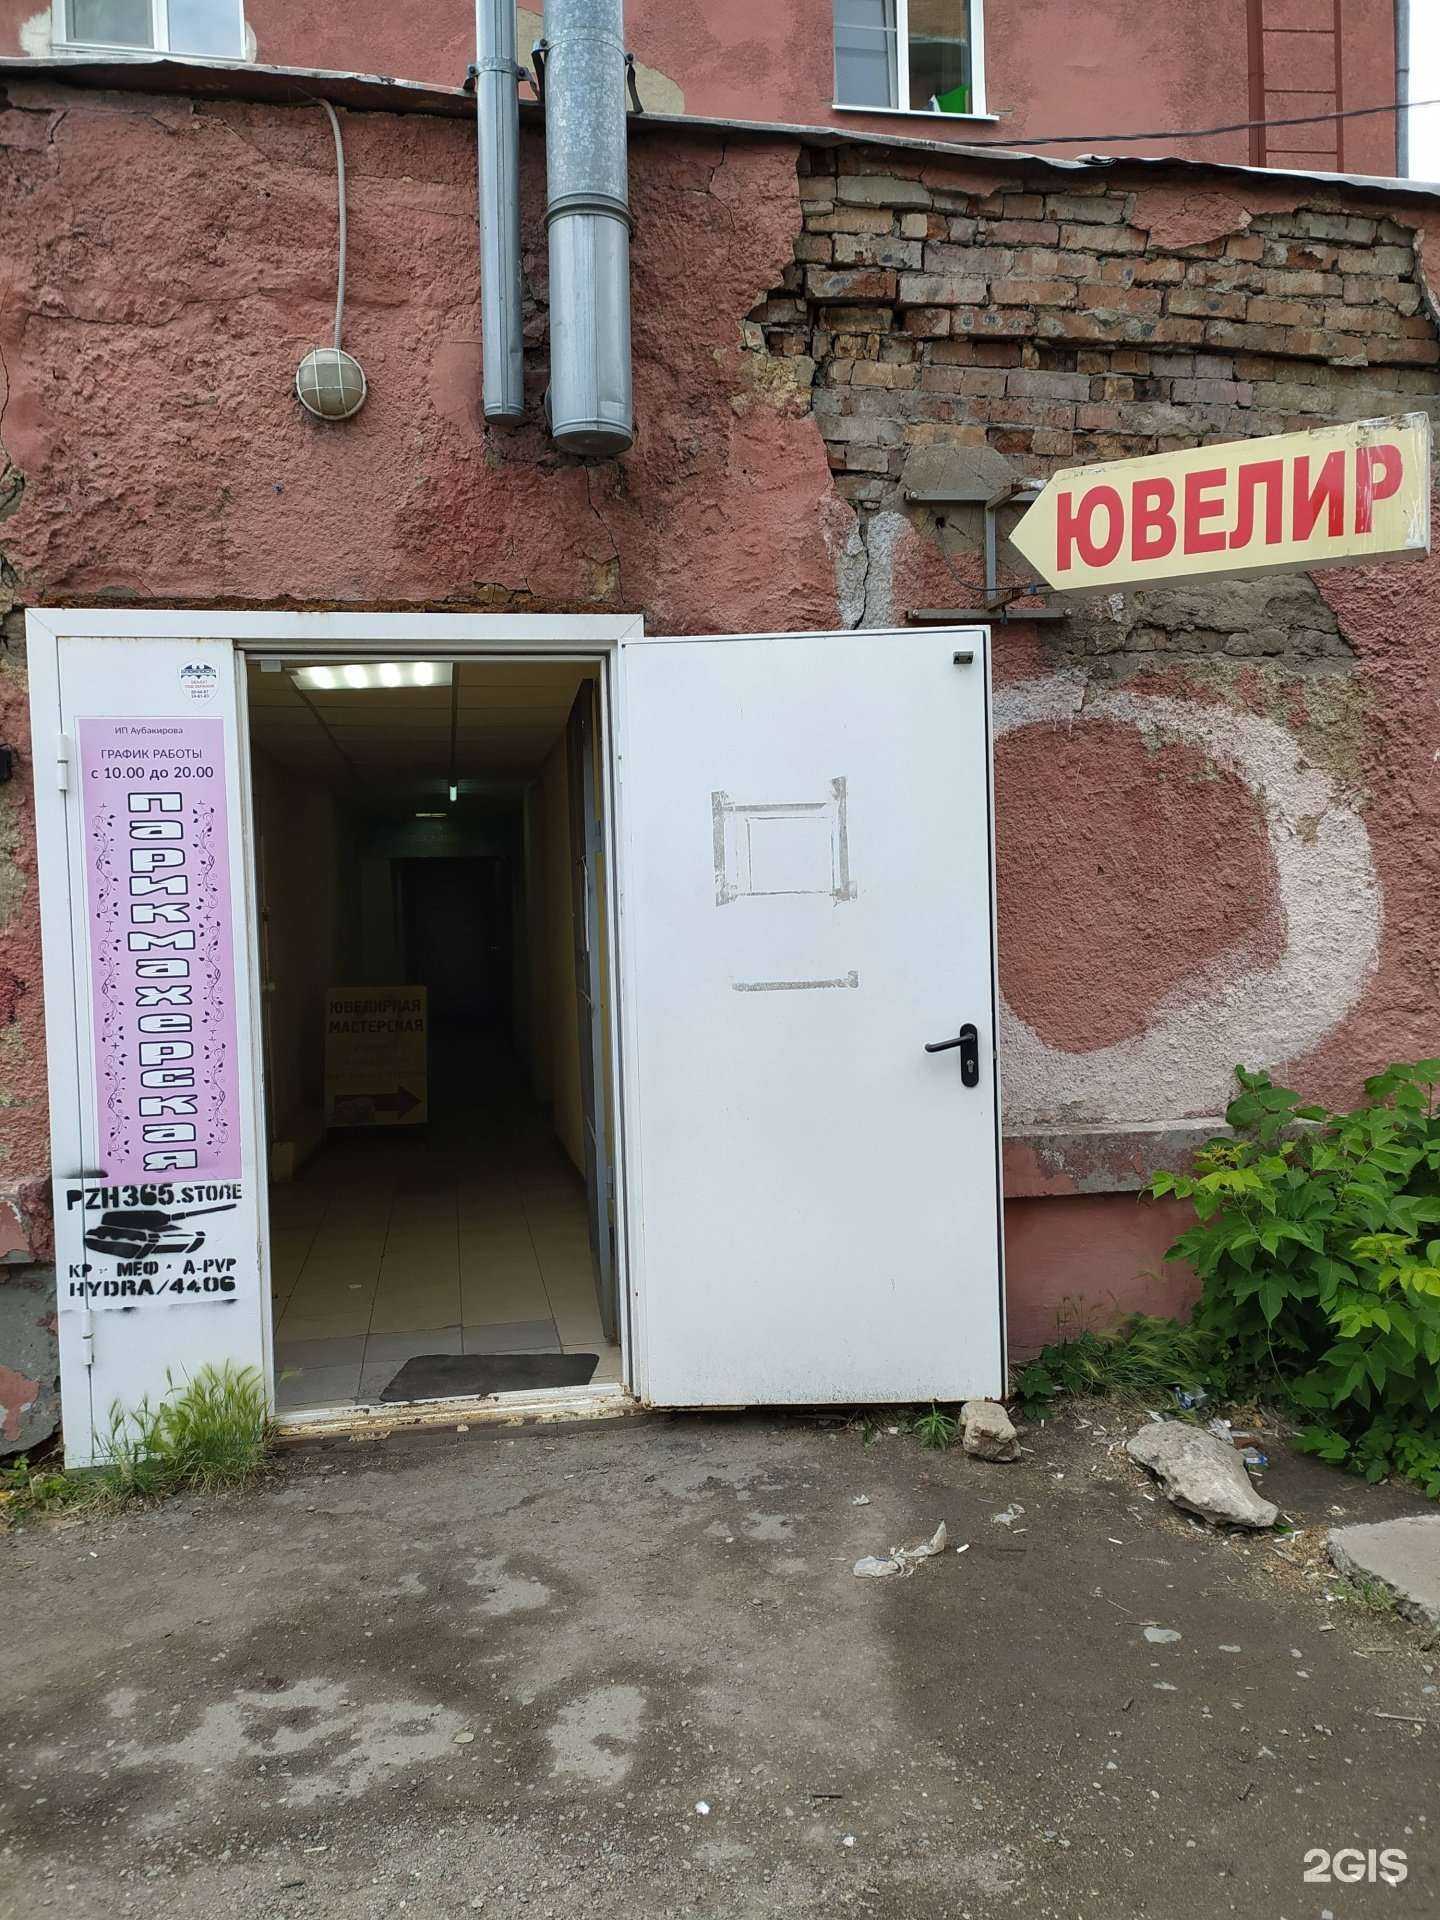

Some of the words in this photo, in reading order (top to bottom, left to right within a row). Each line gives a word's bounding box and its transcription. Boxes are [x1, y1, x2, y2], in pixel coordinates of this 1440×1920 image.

[1056, 443, 1403, 572] ЮВЕЛИР
[115, 727, 128, 735] ИП
[130, 726, 183, 736] Аубакирова
[101, 749, 150, 759] ГРАФИК
[153, 748, 202, 759] РАБОТЫ
[91, 770, 98, 779] с
[104, 767, 145, 779] 10.00
[150, 769, 169, 781] до
[173, 766, 214, 778] 20.00
[329, 999, 422, 1014] ЮВЕЛИРНАЯ
[328, 1019, 424, 1033] МАСТЕРСКАЯ
[67, 1183, 242, 1210] PZH365.STORE
[69, 1275, 236, 1297] HYDRA/4406
